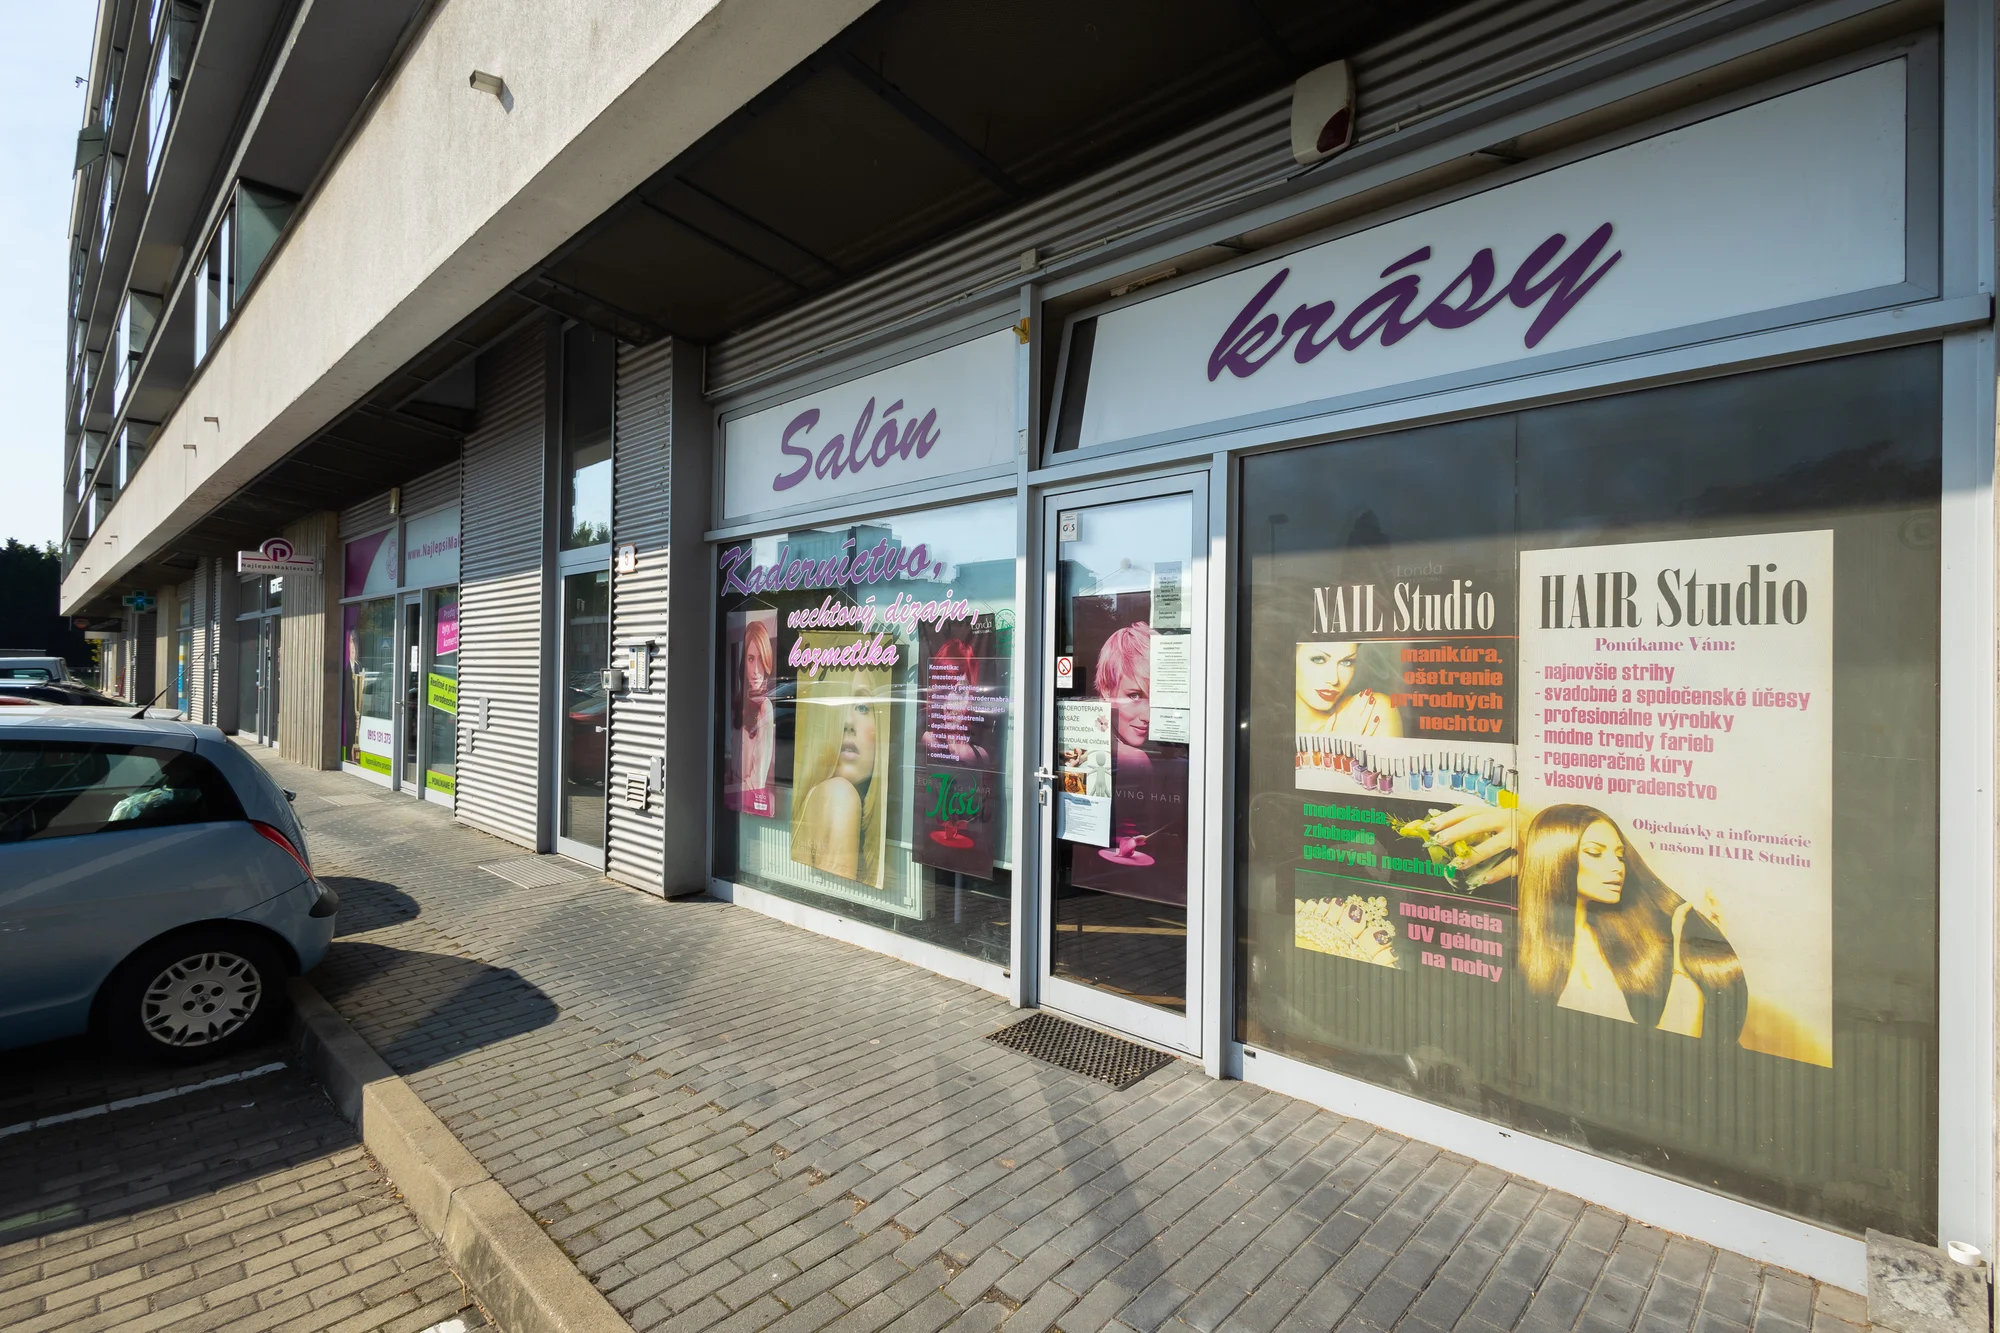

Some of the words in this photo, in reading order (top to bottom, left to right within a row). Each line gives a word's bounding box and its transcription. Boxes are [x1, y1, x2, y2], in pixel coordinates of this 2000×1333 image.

[773, 396, 940, 491] Salón
[1207, 222, 1622, 382] krásy
[720, 537, 943, 596] Kaderníctvo,
[1312, 584, 1384, 634] NAIL
[1393, 579, 1495, 632] Studio
[1539, 571, 1642, 629] HAIR
[1657, 563, 1808, 627] Studio
[787, 595, 876, 634] nechtový
[884, 589, 979, 634] dizajn,
[788, 632, 899, 677] kozmetika
[1401, 646, 1503, 664] manikúra,
[1595, 637, 1684, 651] Ponúkame
[1689, 637, 1736, 651] Vám:
[1404, 668, 1503, 686] ošetrenie
[1544, 662, 1617, 683] najnovšie
[1622, 663, 1675, 683] strihy
[1390, 690, 1503, 711] prírodných
[1544, 684, 1617, 703] svadobné
[1622, 689, 1631, 703] a
[1636, 685, 1747, 706] spoločenské
[1752, 688, 1811, 711] účesy
[1419, 715, 1503, 733] nechtov
[1544, 706, 1652, 727] profesionálne
[1658, 710, 1735, 733] výrobky
[1544, 727, 1593, 746] módne
[1598, 731, 1654, 752] trendy
[1660, 733, 1714, 753] farieb
[1544, 751, 1645, 772] regeneračné
[1650, 755, 1693, 777] kúry
[1150, 792, 1181, 803] HAIR
[1544, 771, 1603, 790] vlasové
[1608, 776, 1717, 801] poradenstvo
[1304, 803, 1391, 827] modelácia,
[1304, 824, 1375, 845] zdobenie
[1632, 818, 1713, 840] Objednávky
[1716, 830, 1724, 839] a
[1729, 828, 1812, 848] informácie
[1304, 844, 1377, 867] gélových
[1382, 855, 1458, 879] nechtov
[1650, 841, 1656, 849] v
[1660, 841, 1704, 855] našom
[1708, 845, 1754, 861] HAIR
[1759, 850, 1811, 868] Studiu
[1400, 902, 1503, 933] modelácia
[1408, 923, 1434, 944] UV
[1440, 932, 1503, 958] gélom
[1421, 950, 1446, 969] na
[1451, 956, 1503, 983] nohy
